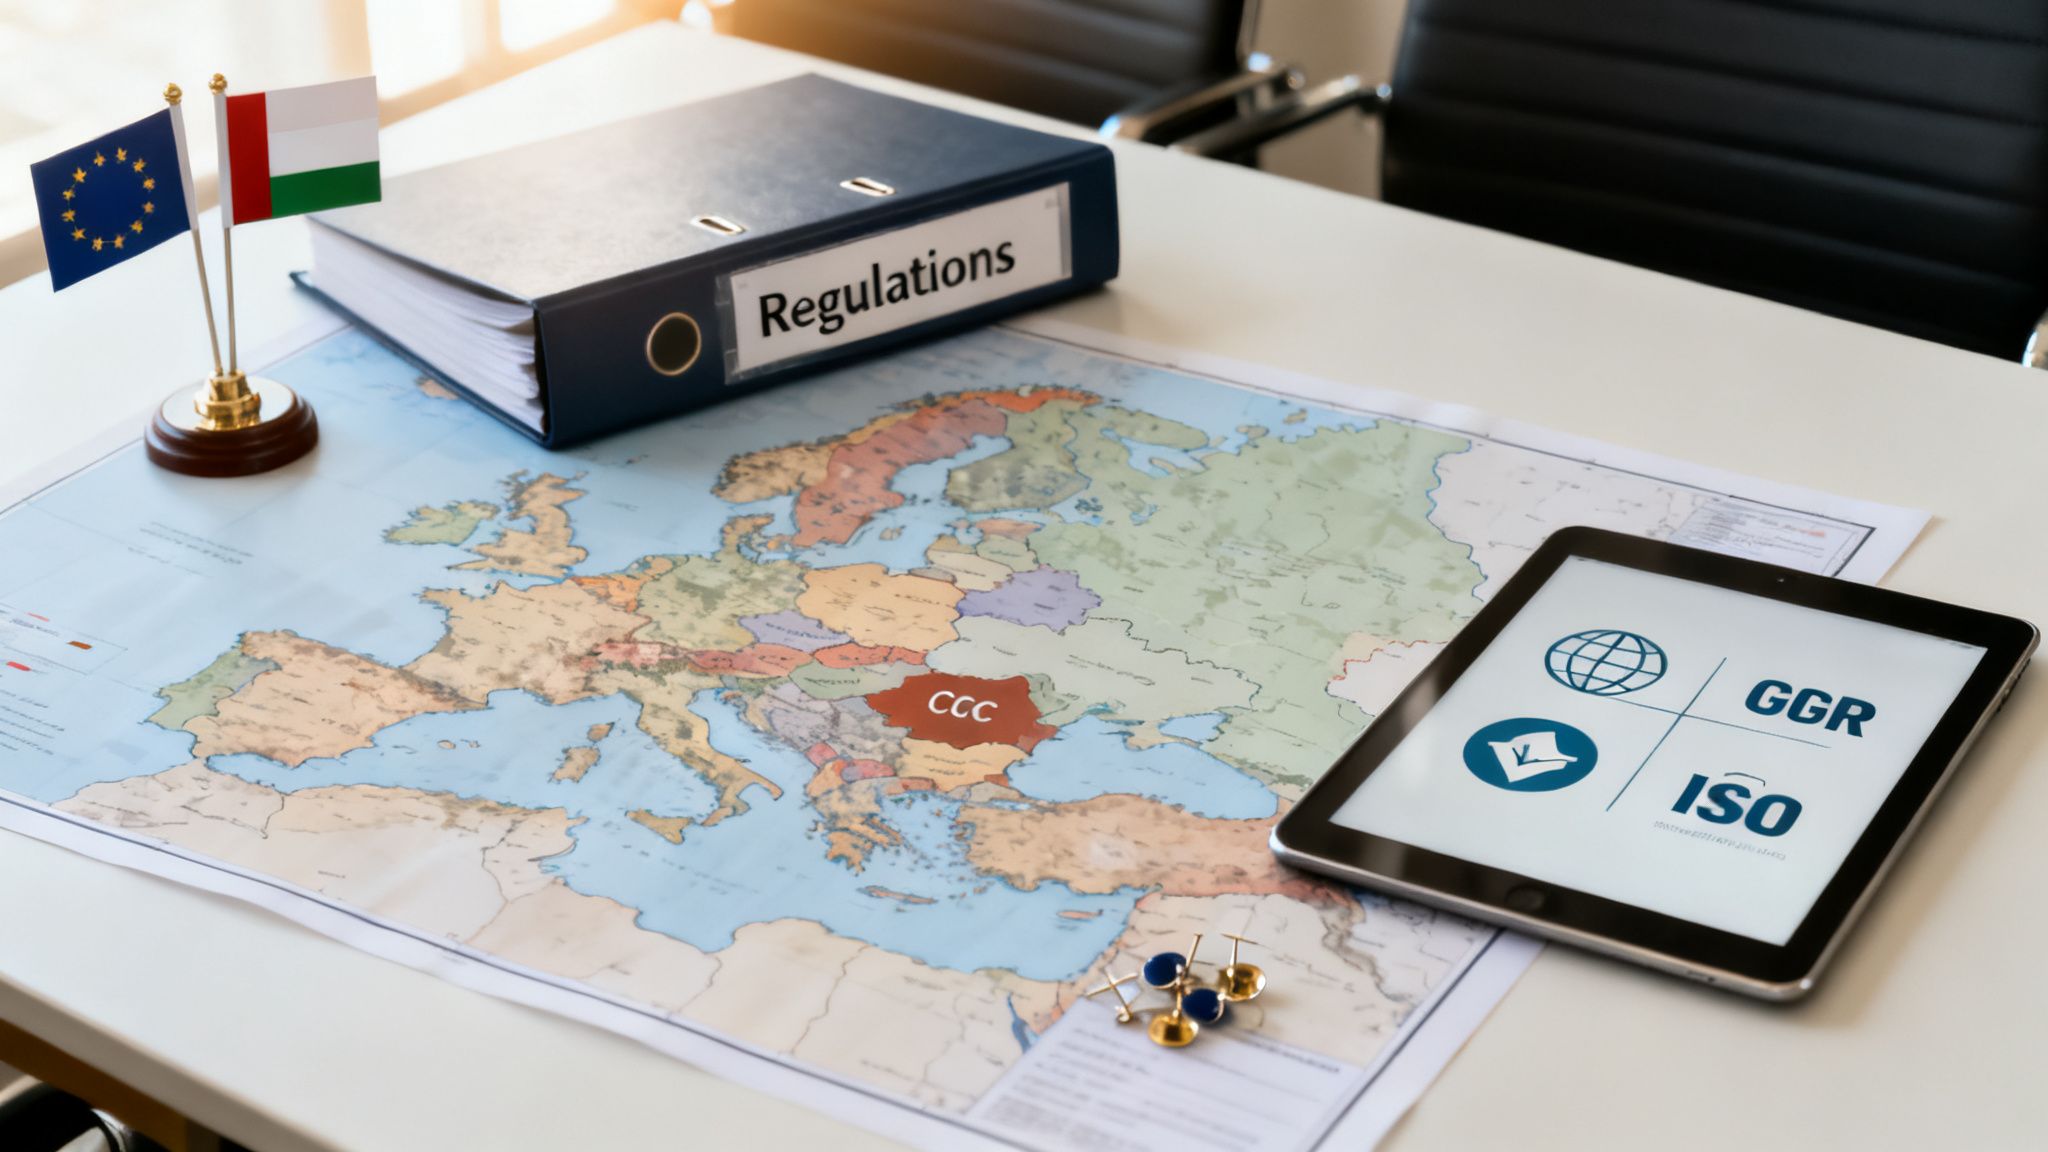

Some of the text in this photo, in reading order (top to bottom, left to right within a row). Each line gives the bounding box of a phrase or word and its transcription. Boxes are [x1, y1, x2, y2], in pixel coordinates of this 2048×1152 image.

[759, 241, 1016, 338] Regulations
[928, 690, 998, 723] CCC
[1744, 679, 1877, 738] GGR
[1671, 773, 1803, 837] ISO
